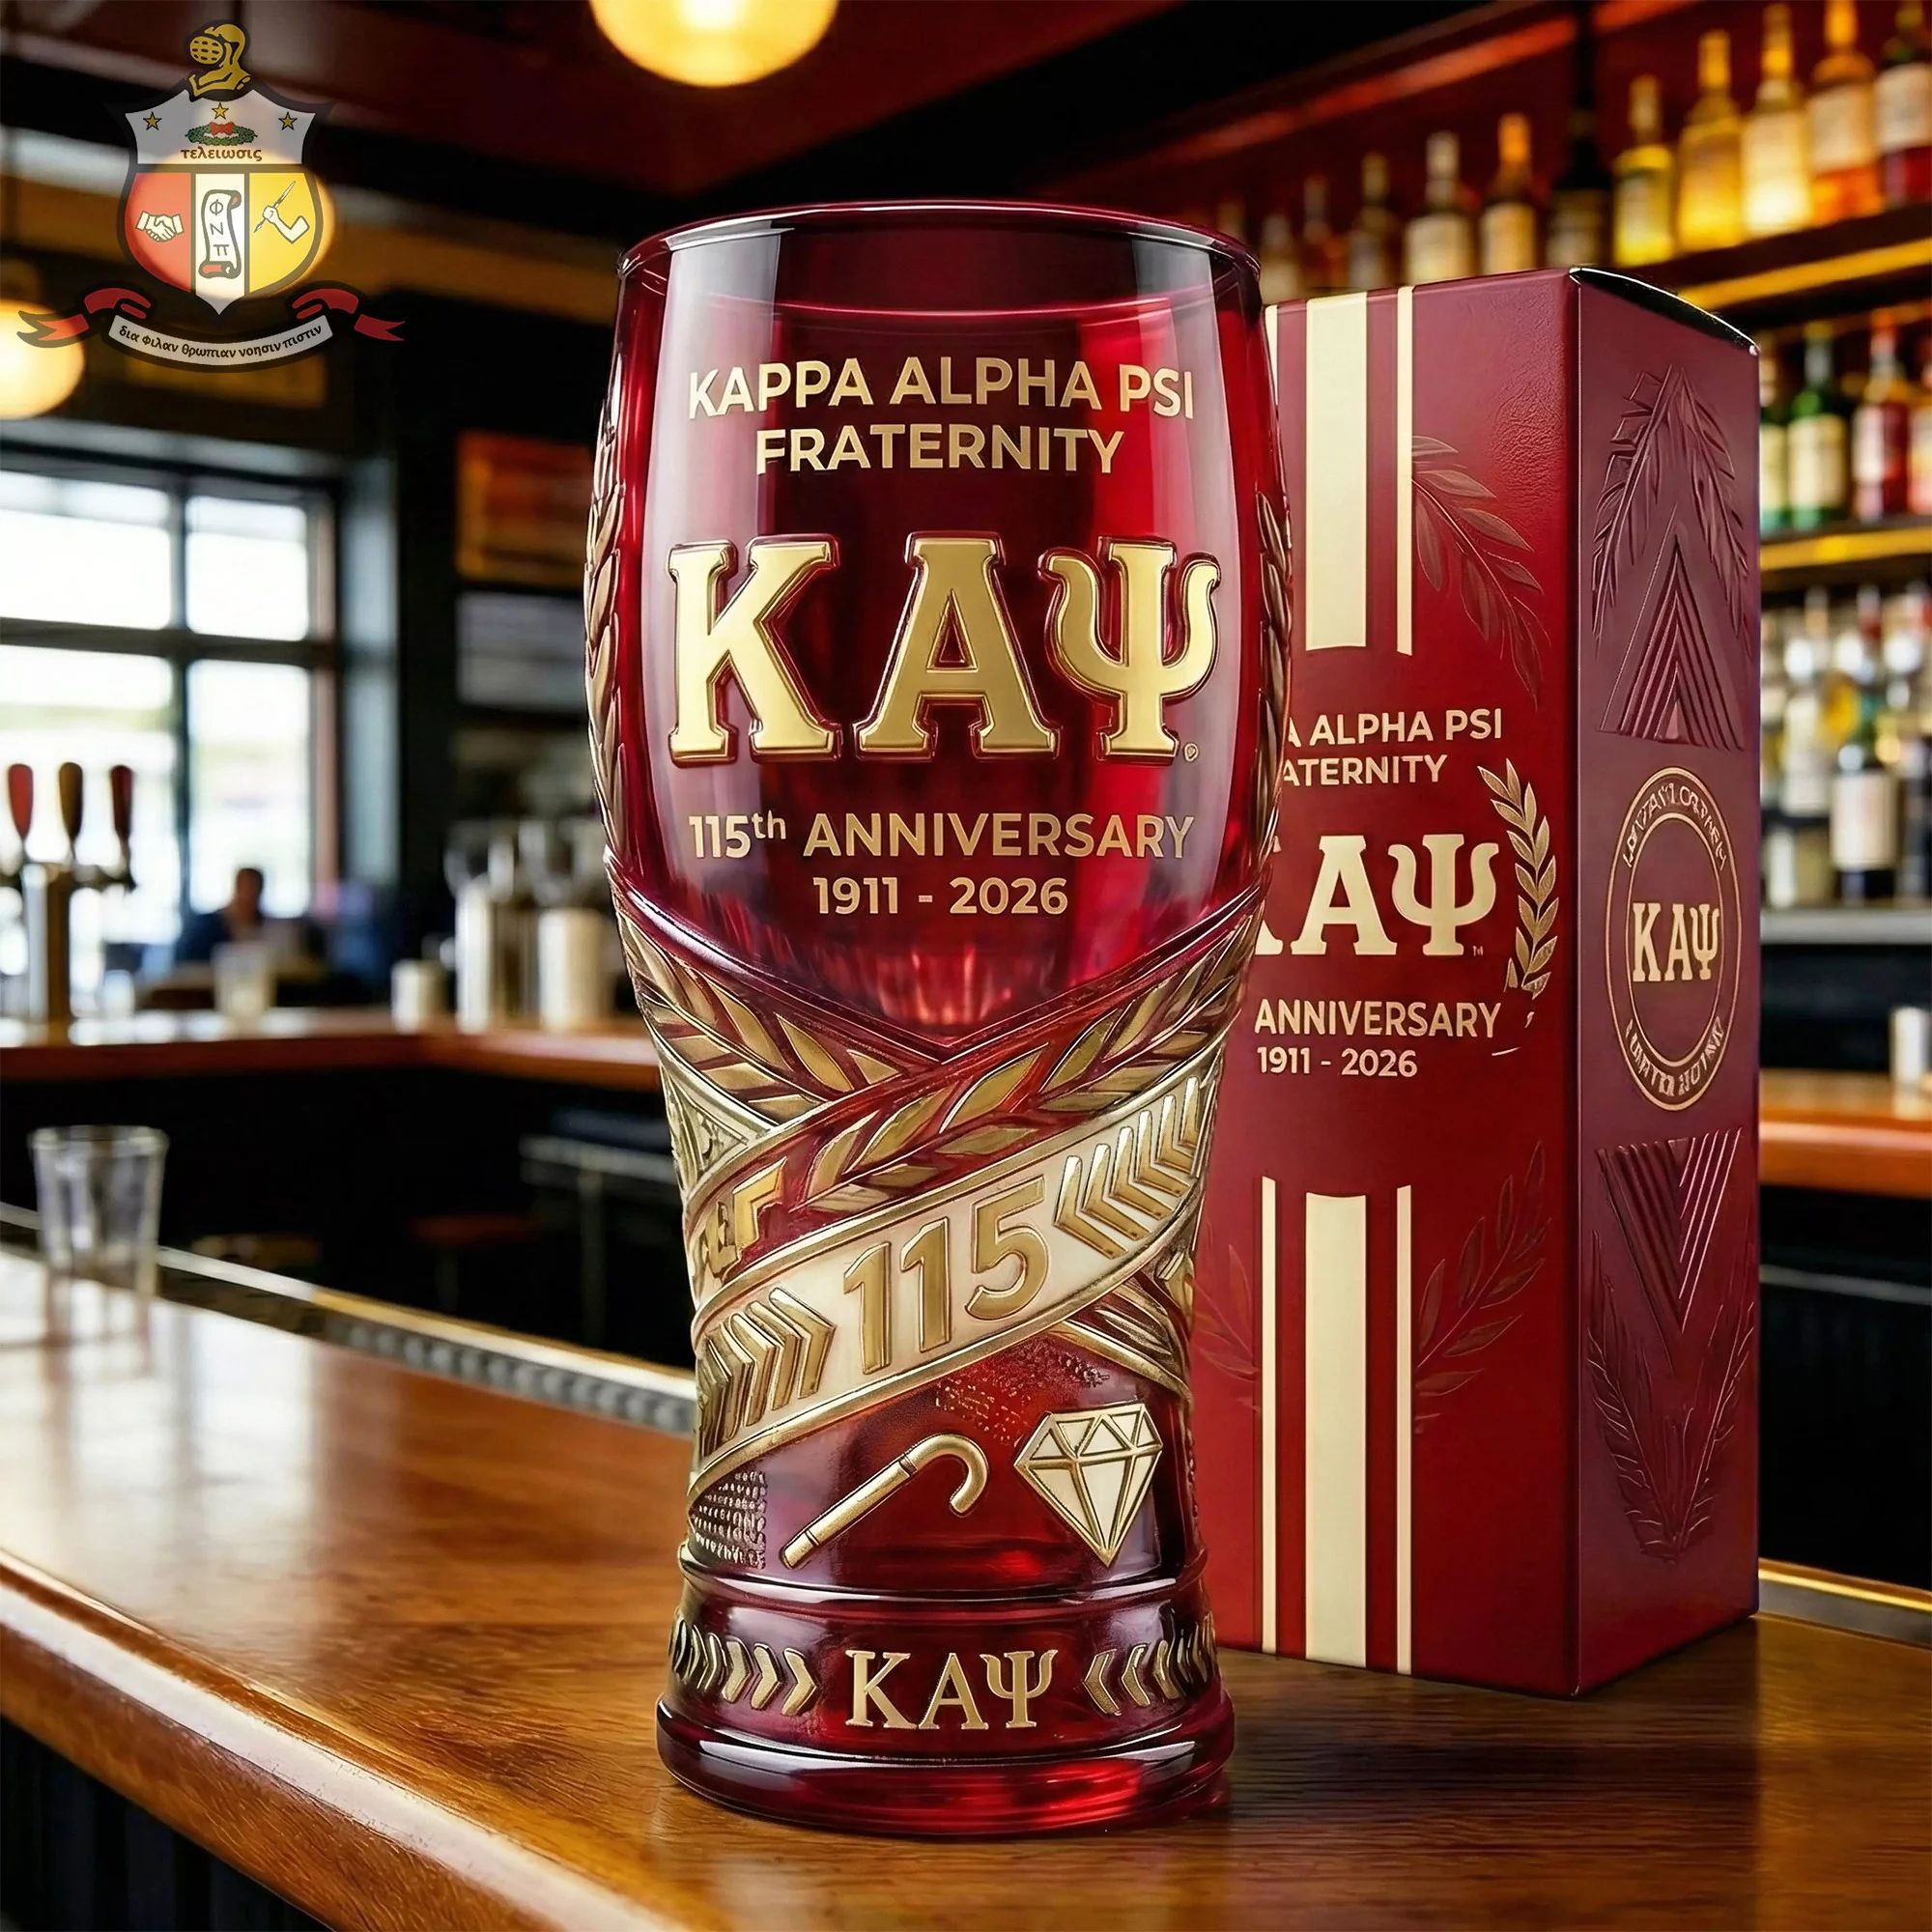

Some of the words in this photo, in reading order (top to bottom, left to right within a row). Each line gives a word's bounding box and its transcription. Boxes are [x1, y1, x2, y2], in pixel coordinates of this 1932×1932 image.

[688, 357, 874, 419] KAPPA
[889, 355, 1102, 408] ALPHA
[1120, 363, 1194, 419] PSI
[755, 423, 1124, 474] FRATERNITY
[1309, 711, 1434, 746] ALPHA
[1445, 708, 1502, 741] PSI
[1283, 754, 1448, 786] ATERNITY
[689, 810, 787, 859] 115th
[803, 812, 1195, 859] ANNIVERSARY
[812, 877, 899, 915] 1911
[950, 877, 1068, 916] 2026
[1255, 834, 1499, 955] ΑΨ
[1254, 998, 1501, 1038] ANNIVERSARY
[1257, 1046, 1310, 1074] 1911
[1341, 1048, 1418, 1077] 2026
[842, 1179, 1050, 1376] 115
